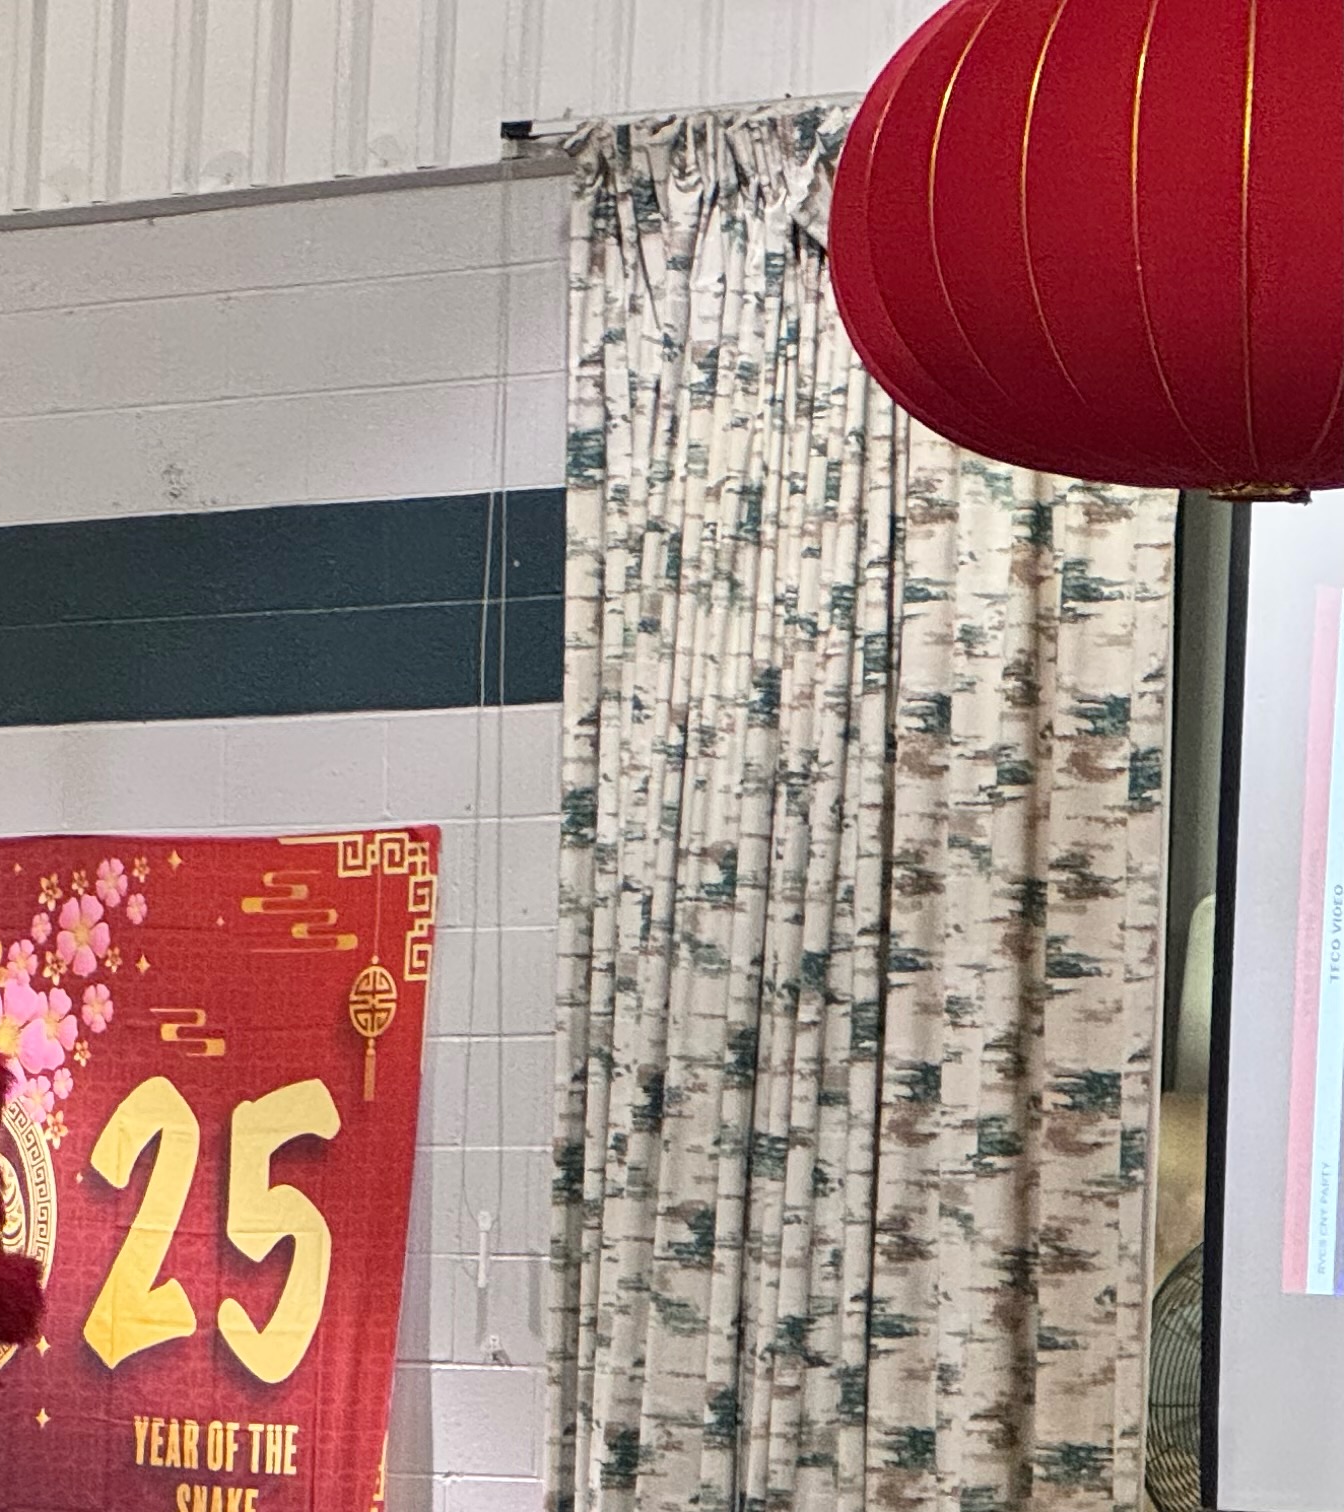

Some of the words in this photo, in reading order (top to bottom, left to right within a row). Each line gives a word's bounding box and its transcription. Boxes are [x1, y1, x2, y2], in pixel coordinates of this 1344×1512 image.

[83, 1076, 341, 1384] 25
[133, 1416, 200, 1470] YEAR
[207, 1420, 240, 1472] OF
[248, 1423, 300, 1475] THE
